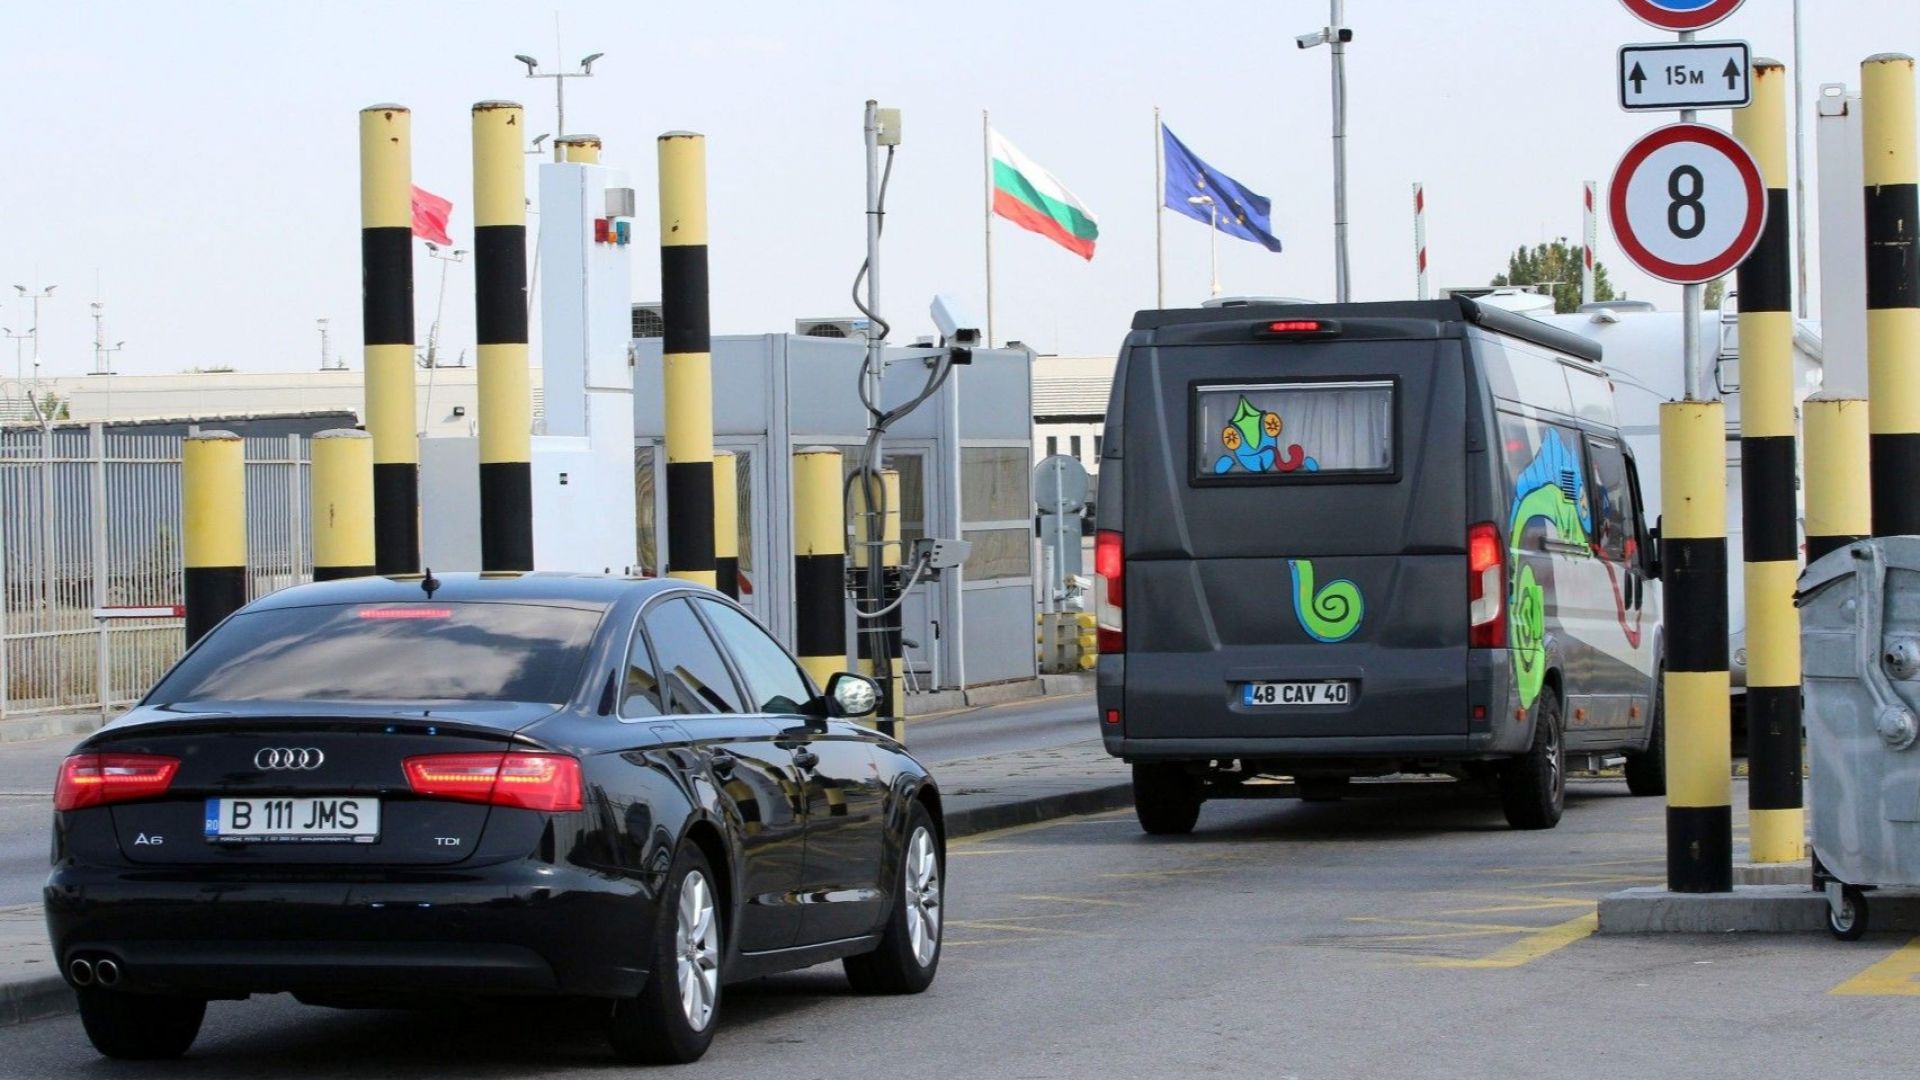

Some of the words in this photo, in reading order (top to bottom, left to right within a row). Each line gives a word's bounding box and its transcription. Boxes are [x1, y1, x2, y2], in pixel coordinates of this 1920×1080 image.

[1668, 164, 1705, 239] 8
[1254, 686, 1275, 703] 48
[1283, 685, 1315, 702] CAV
[1324, 685, 1347, 702] 40
[232, 801, 251, 829] B
[264, 801, 293, 829] 111
[303, 801, 359, 829] JMS
[206, 819, 218, 830] RO
[134, 832, 163, 845] A6
[433, 837, 460, 846] TDI
